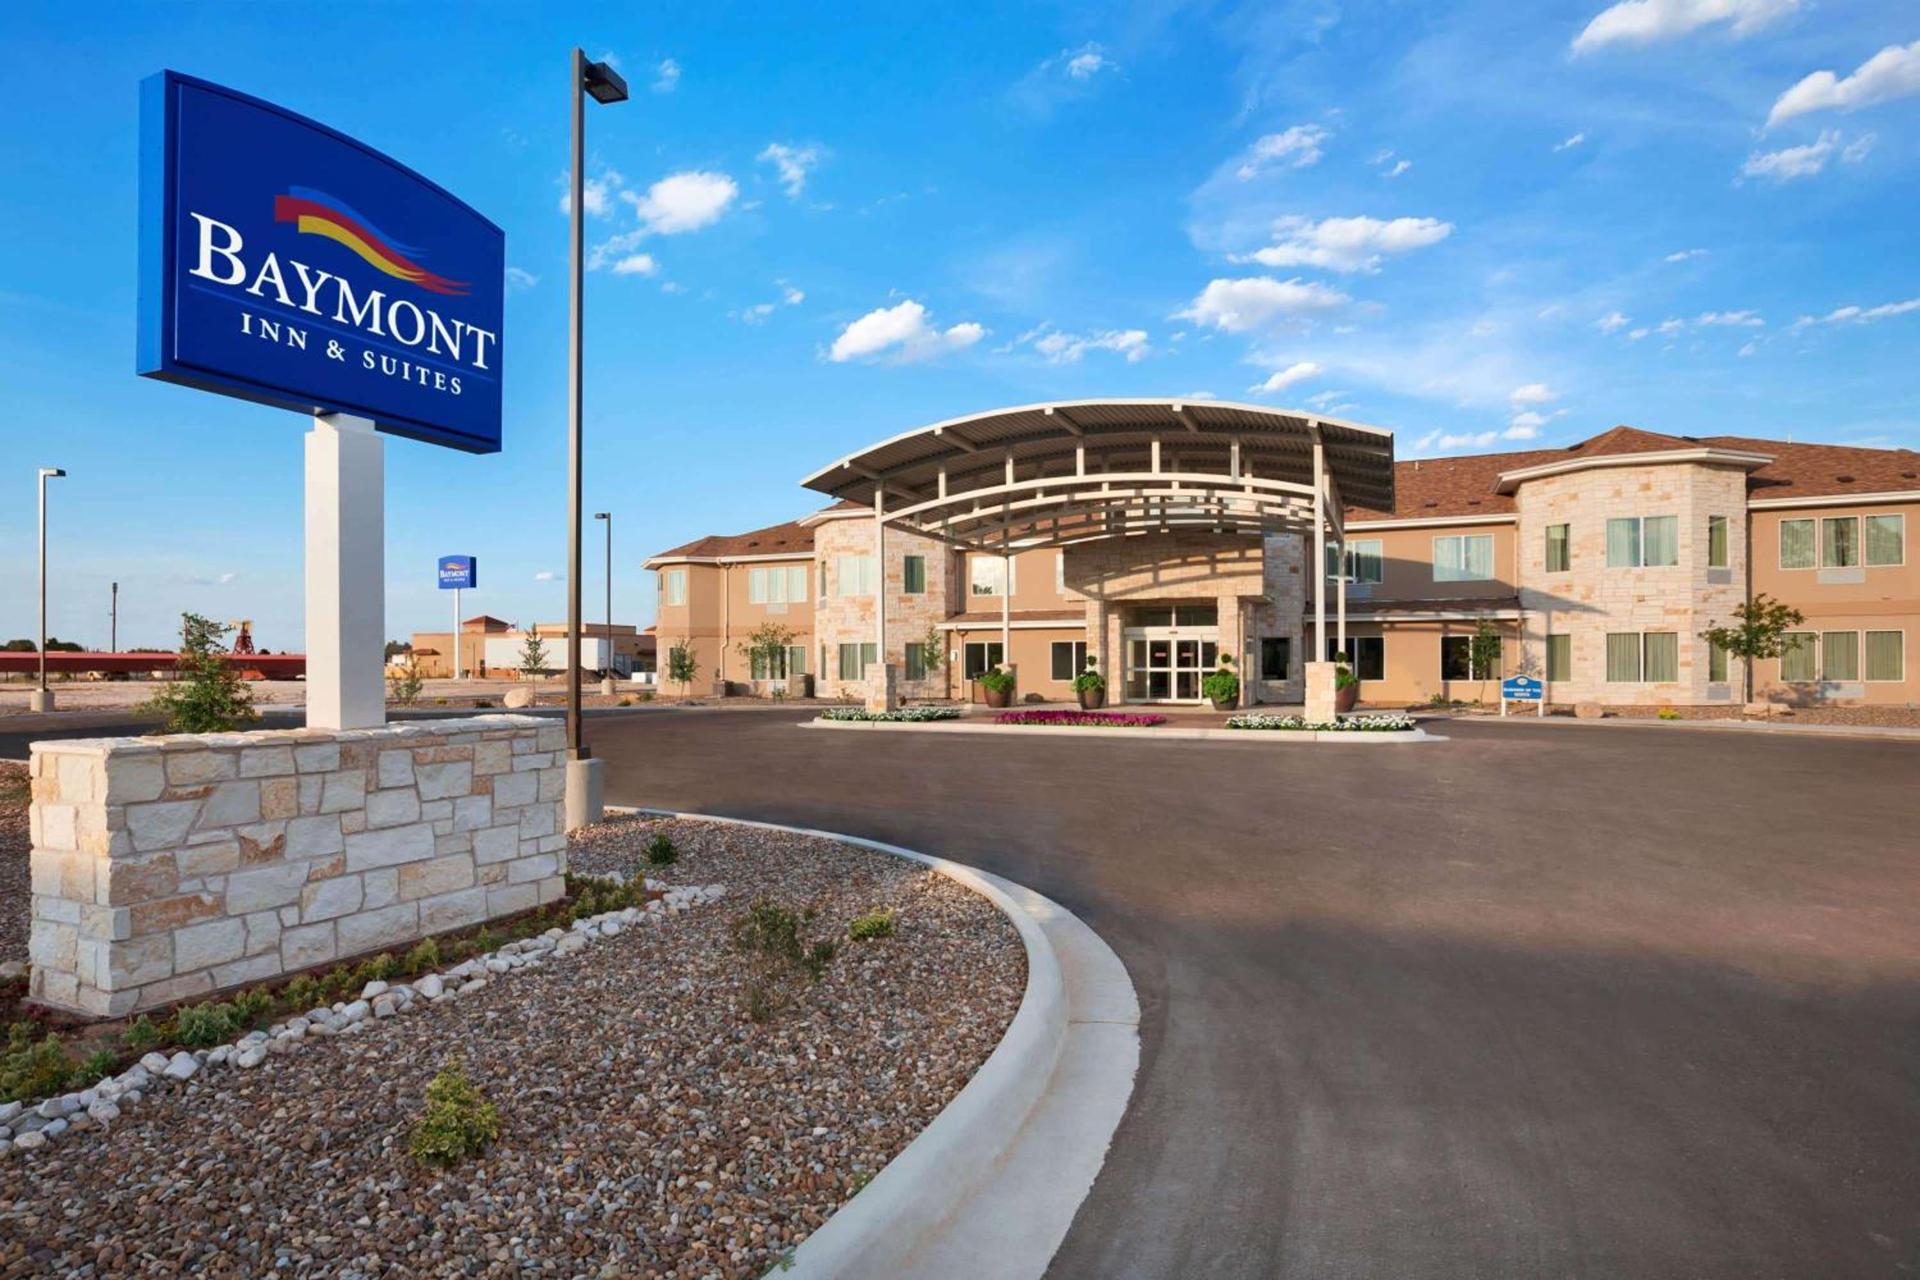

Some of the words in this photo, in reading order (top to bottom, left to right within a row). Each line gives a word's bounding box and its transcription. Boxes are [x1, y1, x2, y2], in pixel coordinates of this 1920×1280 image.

[189, 212, 496, 370] BAYMONT
[241, 313, 307, 350] INN
[326, 340, 346, 362] &
[363, 350, 462, 395] SUITES
